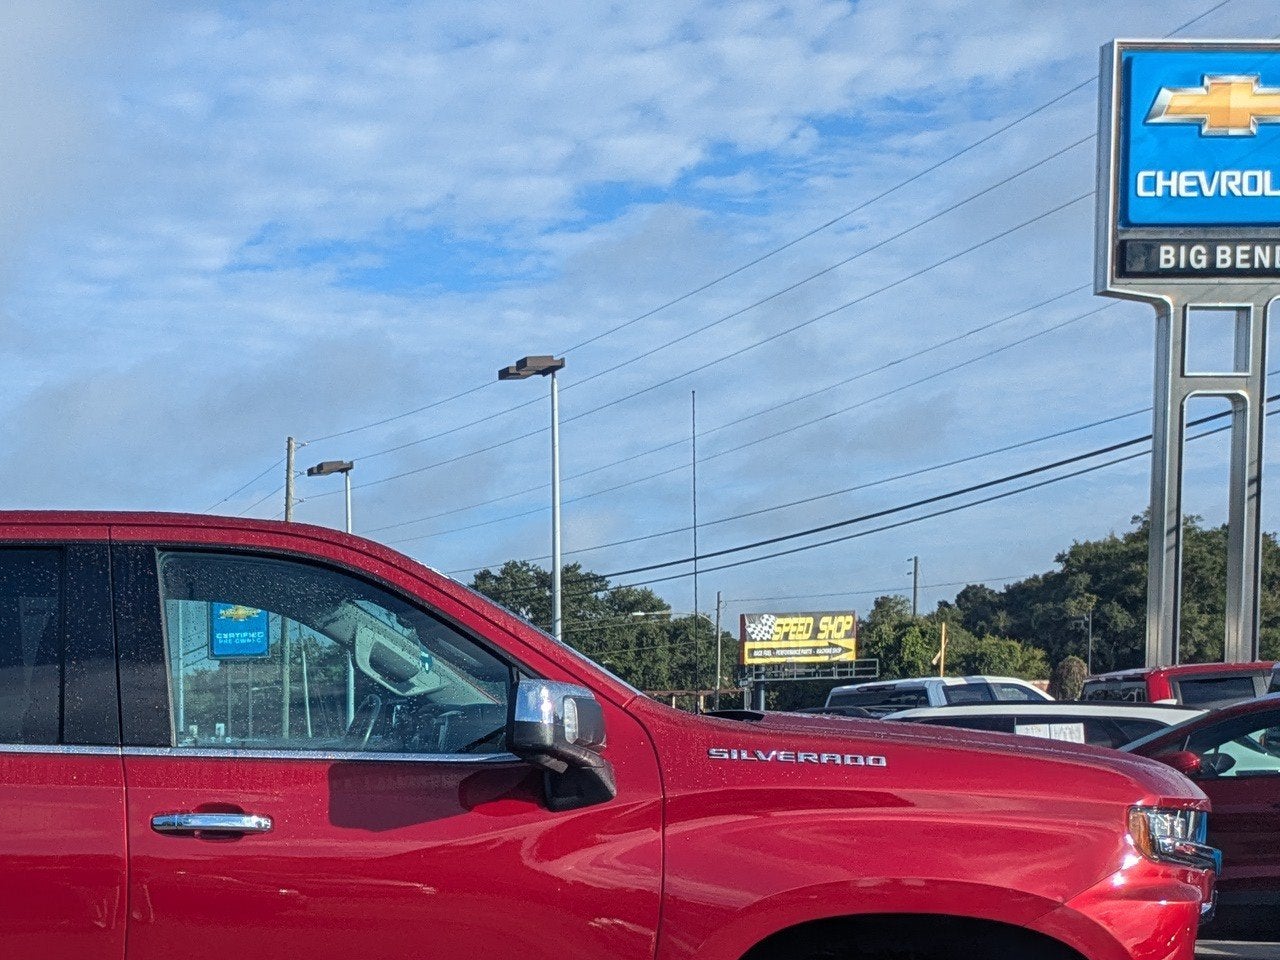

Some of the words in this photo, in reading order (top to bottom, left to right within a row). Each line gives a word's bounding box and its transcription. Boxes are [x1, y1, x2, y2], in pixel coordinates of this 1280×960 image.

[1159, 245, 1207, 269] BIG
[772, 616, 814, 640] SPEED
[817, 615, 854, 638] SHOP
[709, 748, 887, 767] SILVERADO
